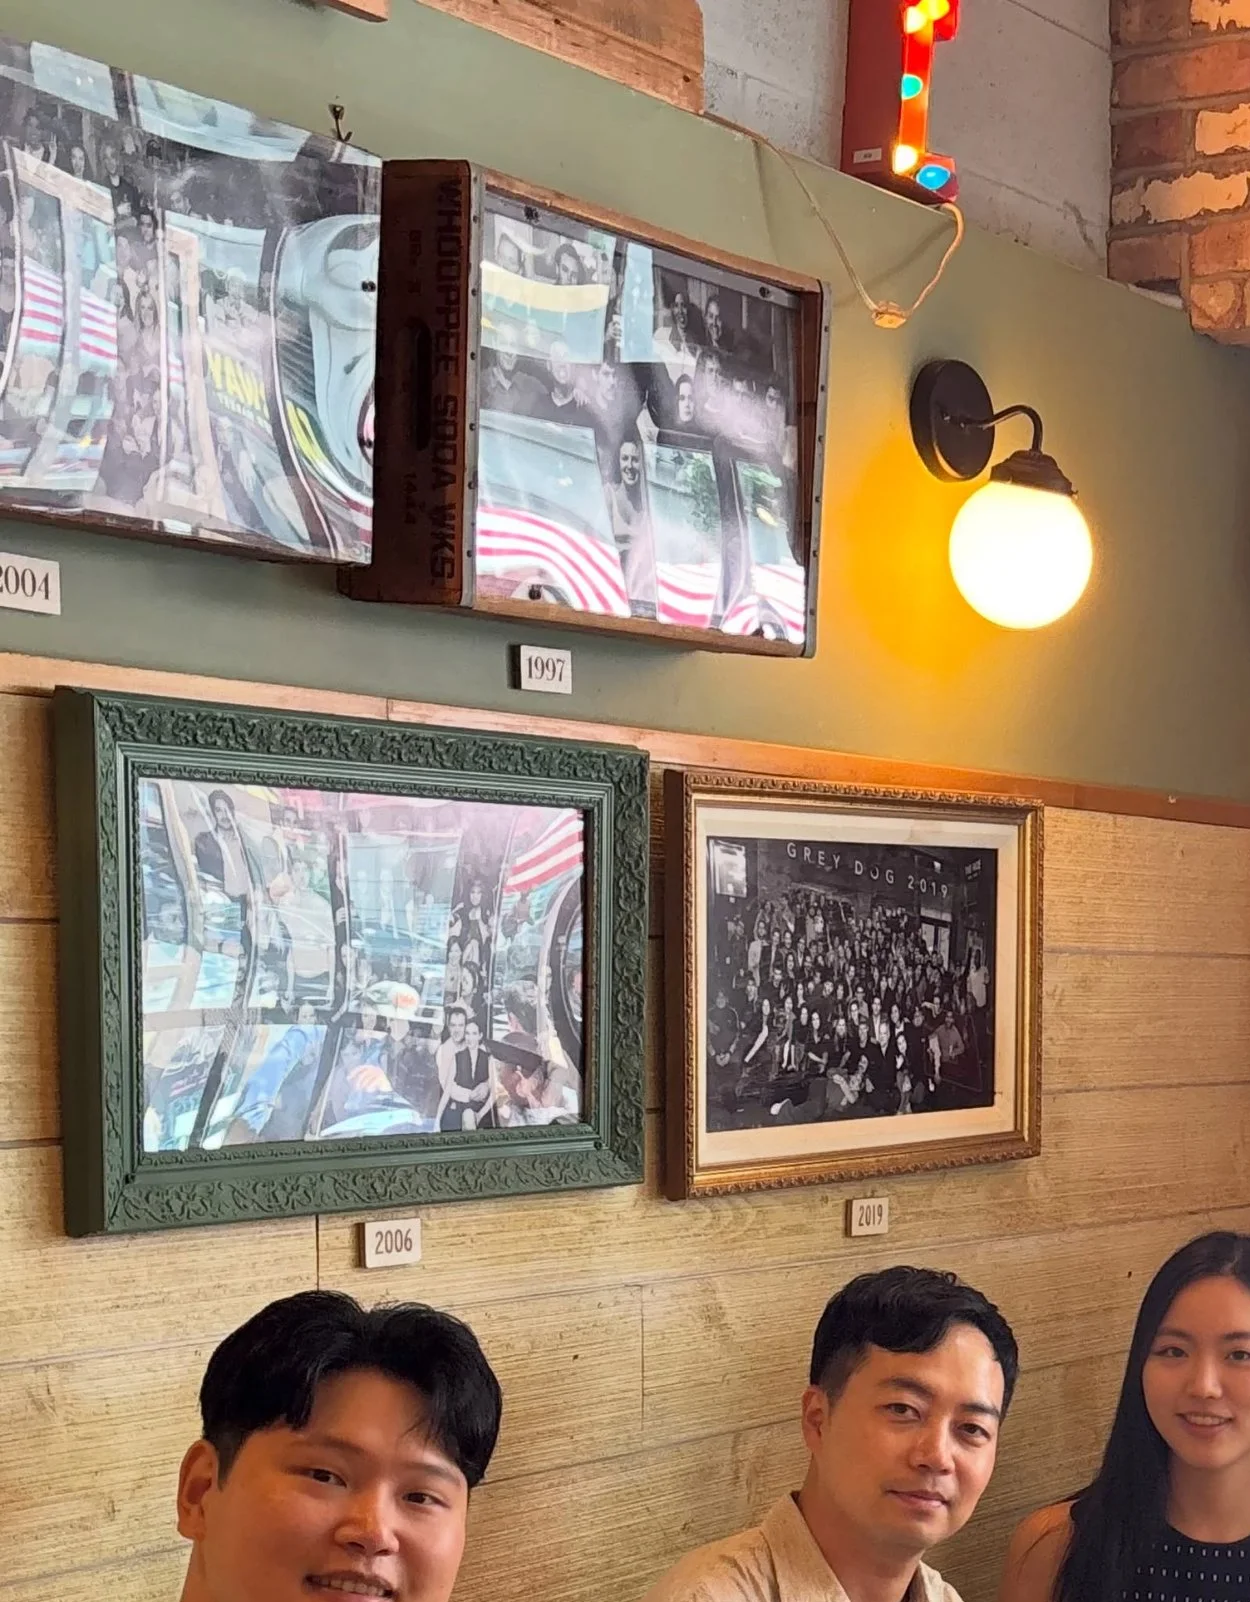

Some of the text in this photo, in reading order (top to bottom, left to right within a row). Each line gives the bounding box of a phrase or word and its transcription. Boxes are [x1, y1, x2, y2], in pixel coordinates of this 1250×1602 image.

[432, 393, 458, 490] SODA
[526, 655, 566, 682] 1997
[786, 842, 949, 898] GREY DOG 2019
[858, 1203, 883, 1227] 2019
[375, 1228, 413, 1255] 2006
